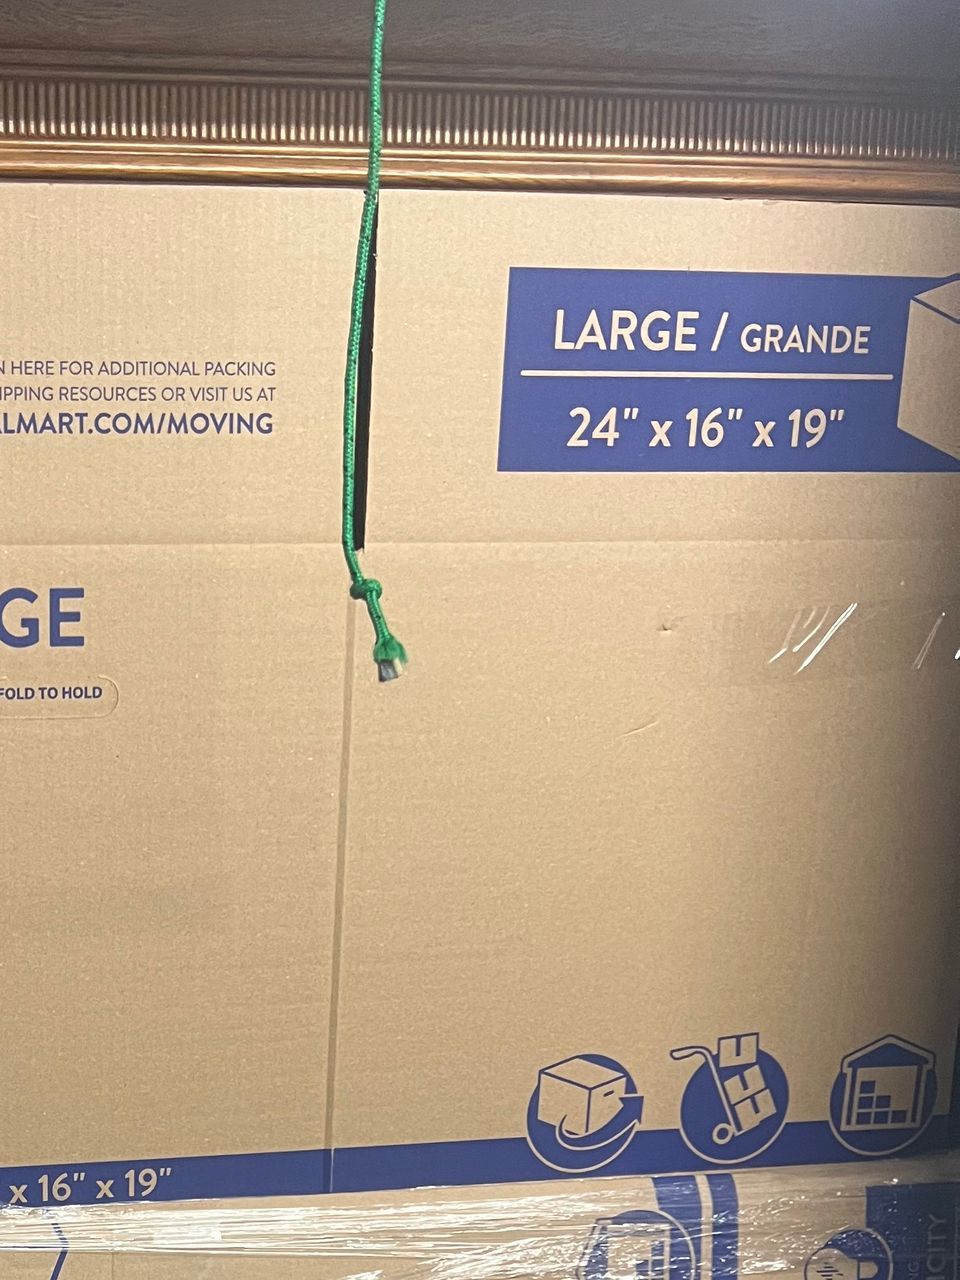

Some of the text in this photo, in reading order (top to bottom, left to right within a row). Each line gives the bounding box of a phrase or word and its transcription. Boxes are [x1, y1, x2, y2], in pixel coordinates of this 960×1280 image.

[553, 308, 871, 354] LARGE / GRANDE
[11, 360, 54, 376] HERE
[59, 360, 94, 376] FOR
[97, 361, 200, 376] ADDITIONAL
[204, 361, 276, 376] PACKING
[59, 386, 157, 401] RESOURCES
[161, 387, 186, 401] OR
[190, 387, 228, 401] VISIT
[232, 387, 253, 402] US
[256, 387, 276, 401] AT
[566, 406, 846, 449] 24" x 16" x 19"
[39, 687, 58, 700] TO
[62, 686, 103, 700] HOLD
[9, 1184, 28, 1203] x
[38, 1172, 85, 1202] 16"
[96, 1179, 114, 1199] x
[124, 1167, 172, 1197] 19"
